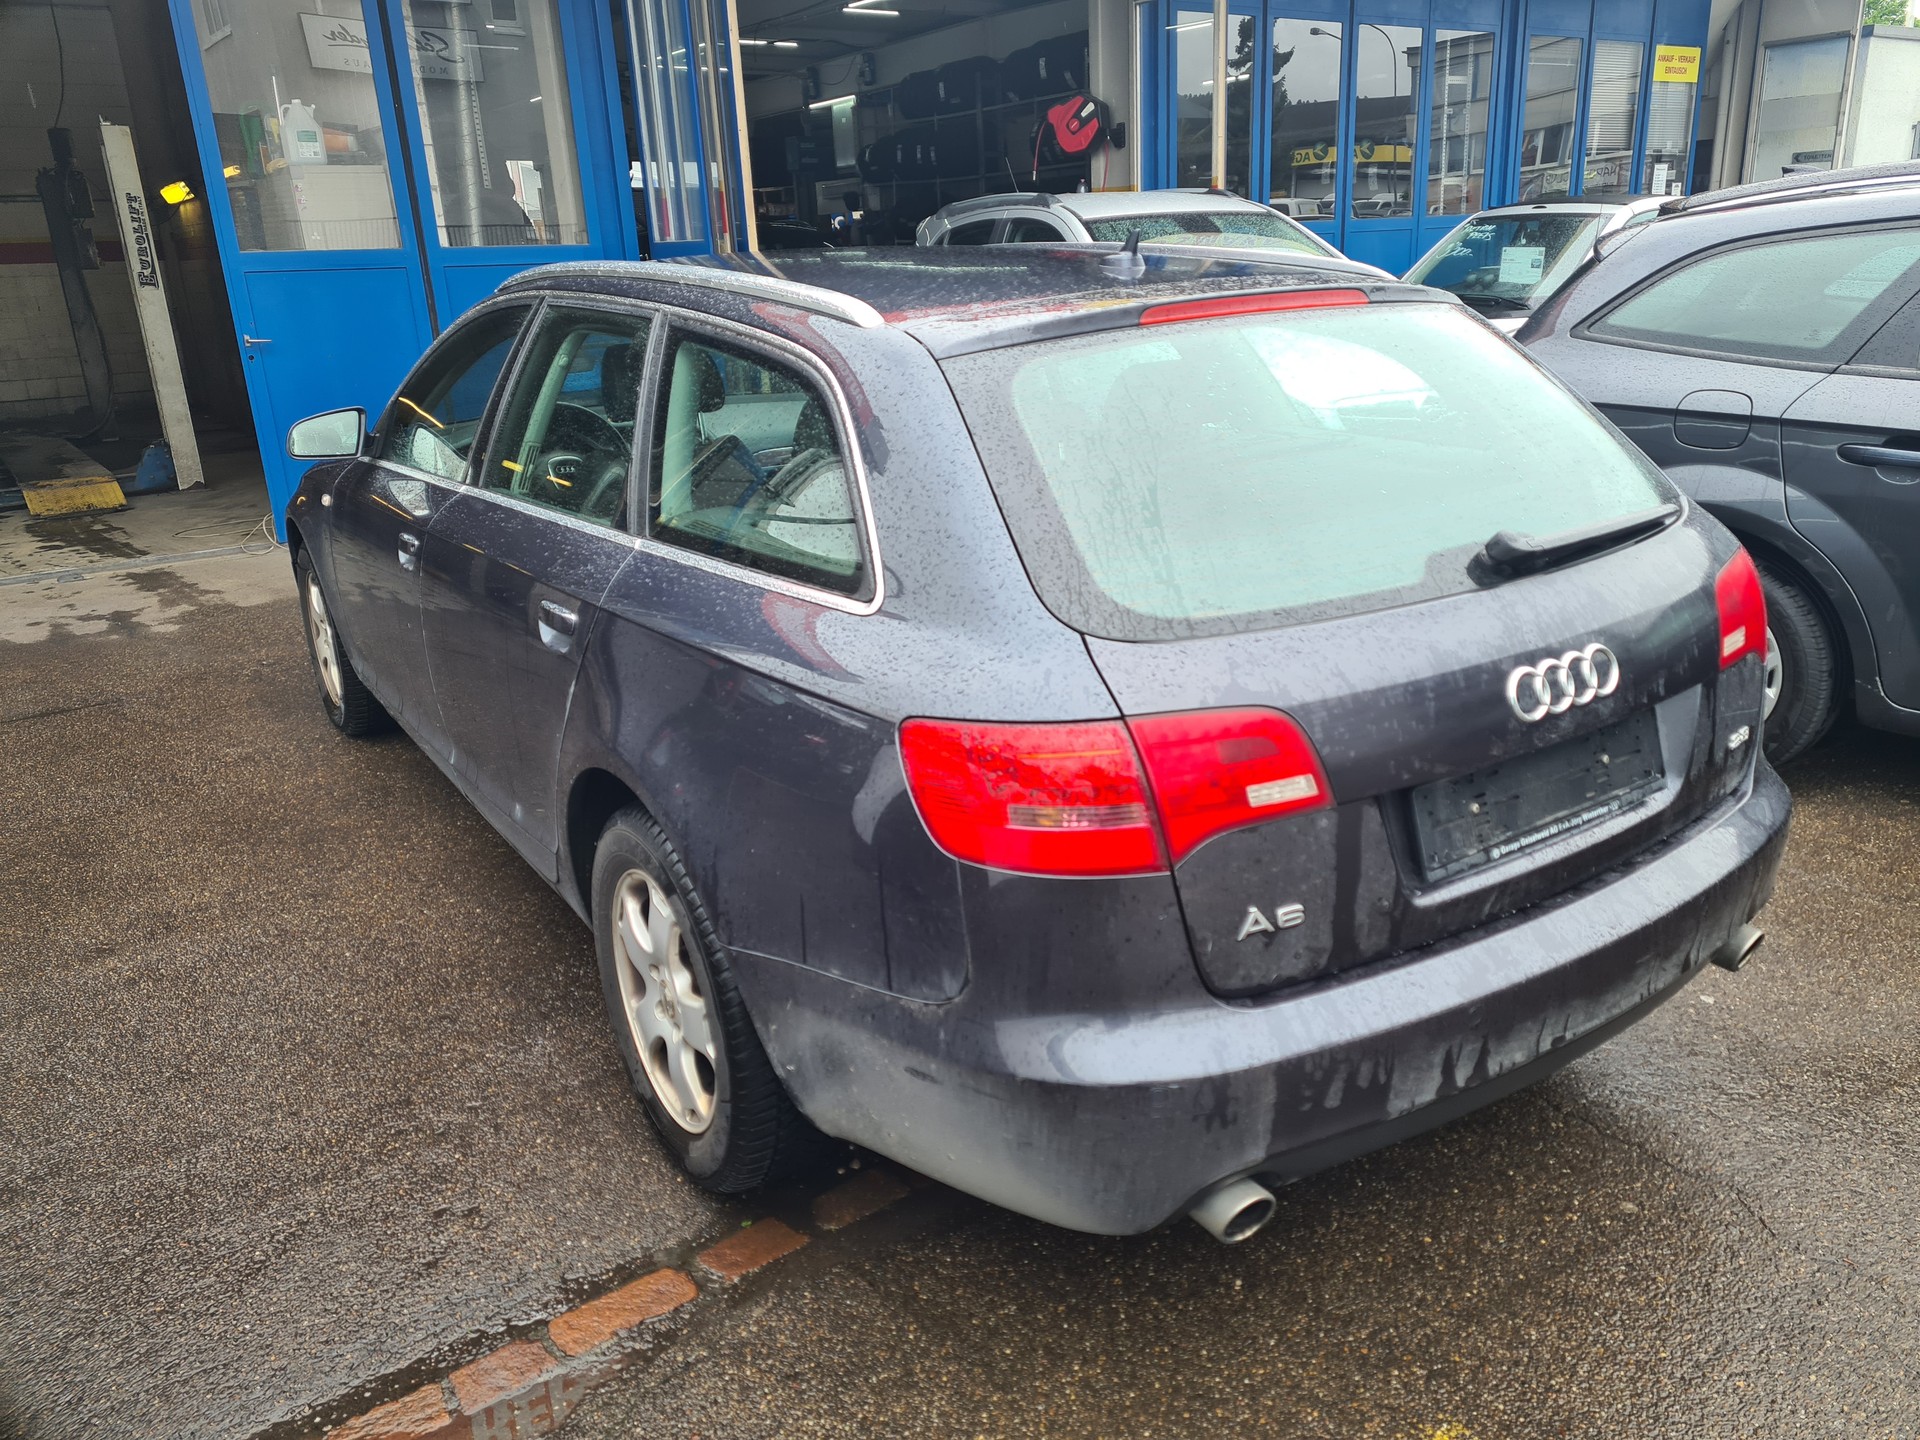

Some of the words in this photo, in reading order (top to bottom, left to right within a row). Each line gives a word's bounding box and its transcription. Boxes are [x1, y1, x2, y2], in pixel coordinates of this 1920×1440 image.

[1665, 66, 1687, 74] EINTAUSCH
[1501, 841, 1521, 855] Garage
[1237, 906, 1305, 941] A6
